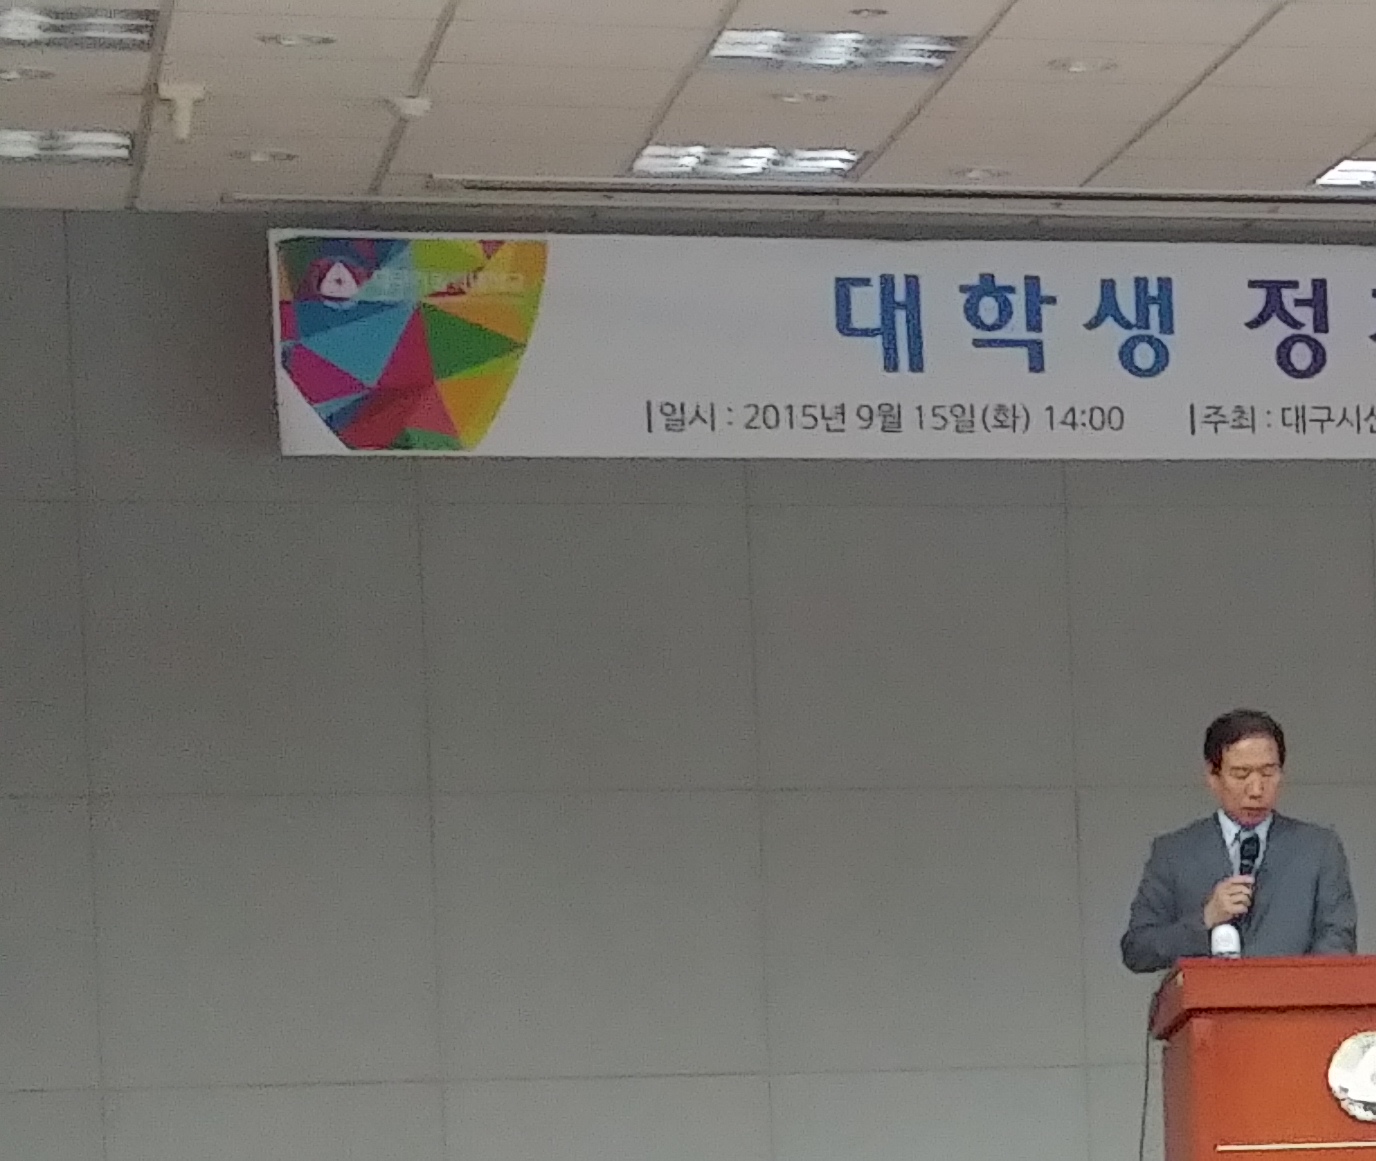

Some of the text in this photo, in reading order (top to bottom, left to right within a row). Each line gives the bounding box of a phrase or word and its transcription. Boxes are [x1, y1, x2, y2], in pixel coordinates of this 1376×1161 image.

[833, 272, 1176, 379] 대학생
[744, 402, 846, 434] 2015년
[855, 402, 903, 434] 9월
[915, 403, 1031, 435] 15일(화)
[1044, 404, 1125, 432] 14:00
